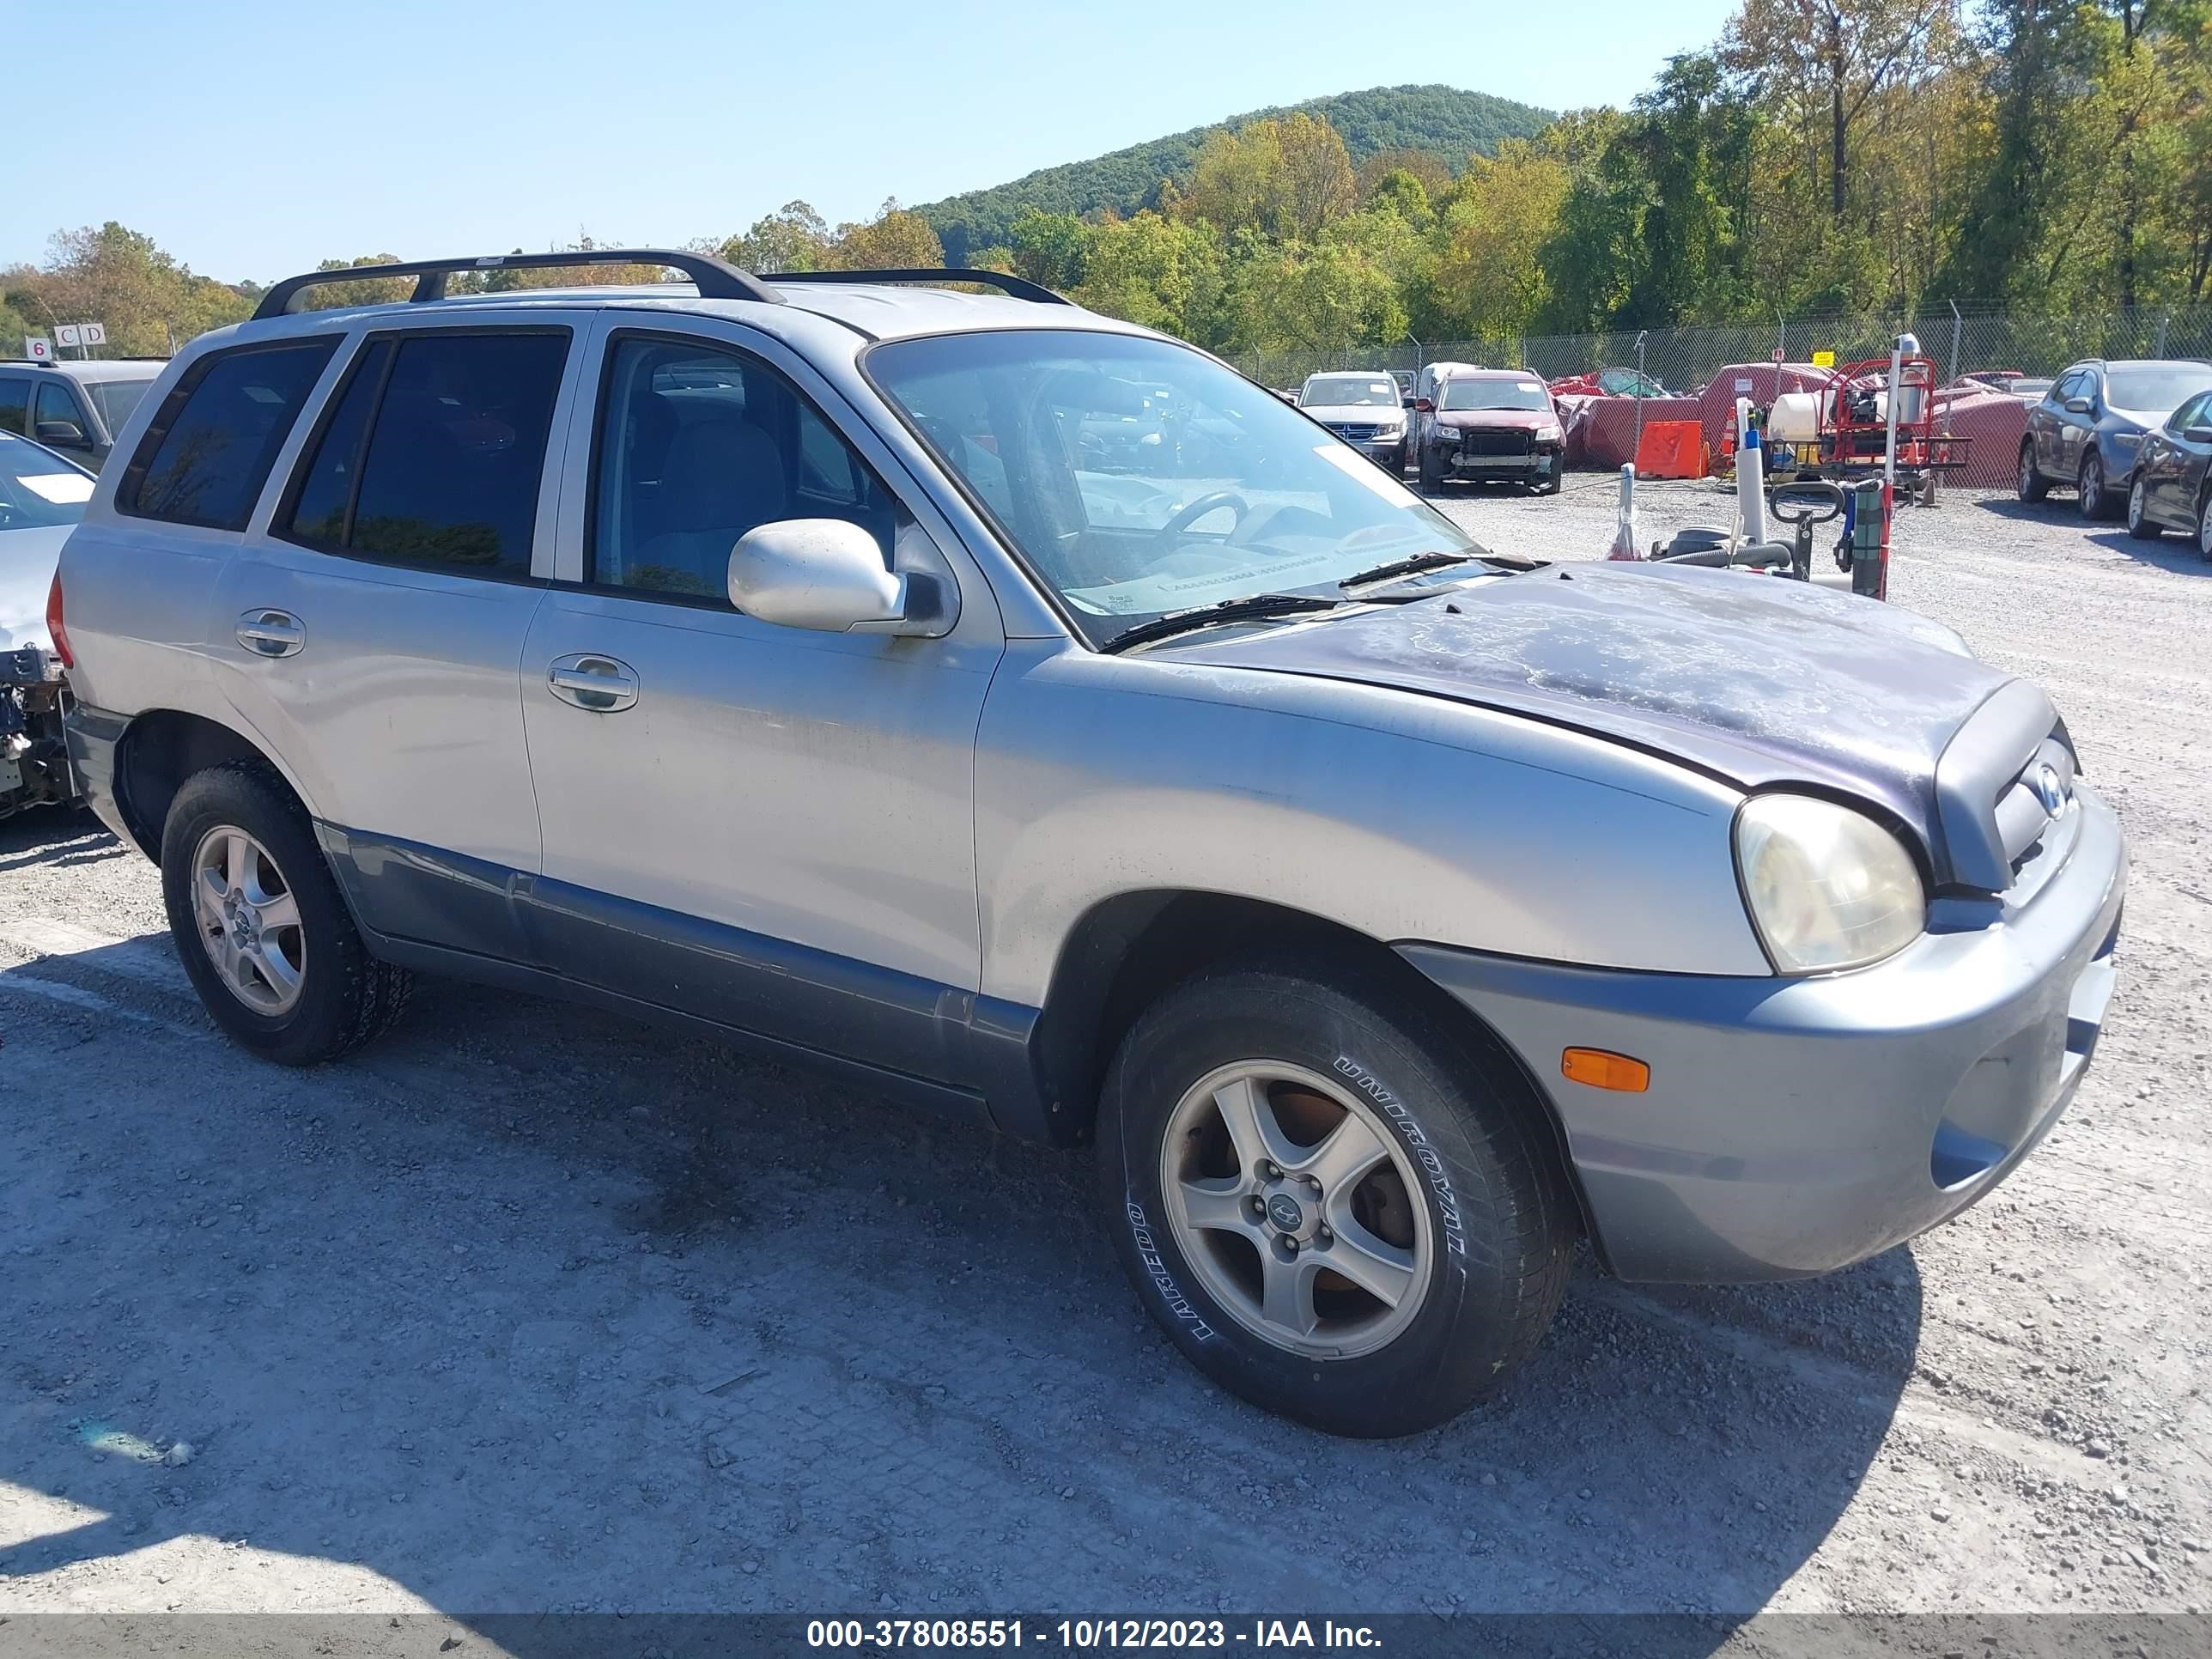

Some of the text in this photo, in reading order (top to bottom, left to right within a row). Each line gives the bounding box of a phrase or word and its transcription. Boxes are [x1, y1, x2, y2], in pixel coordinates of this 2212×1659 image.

[61, 329, 75, 343] C
[87, 327, 100, 342] D
[33, 342, 45, 356] 6
[1334, 1056, 1465, 1255] UNIROYAL
[1127, 1203, 1215, 1340] LAREDO
